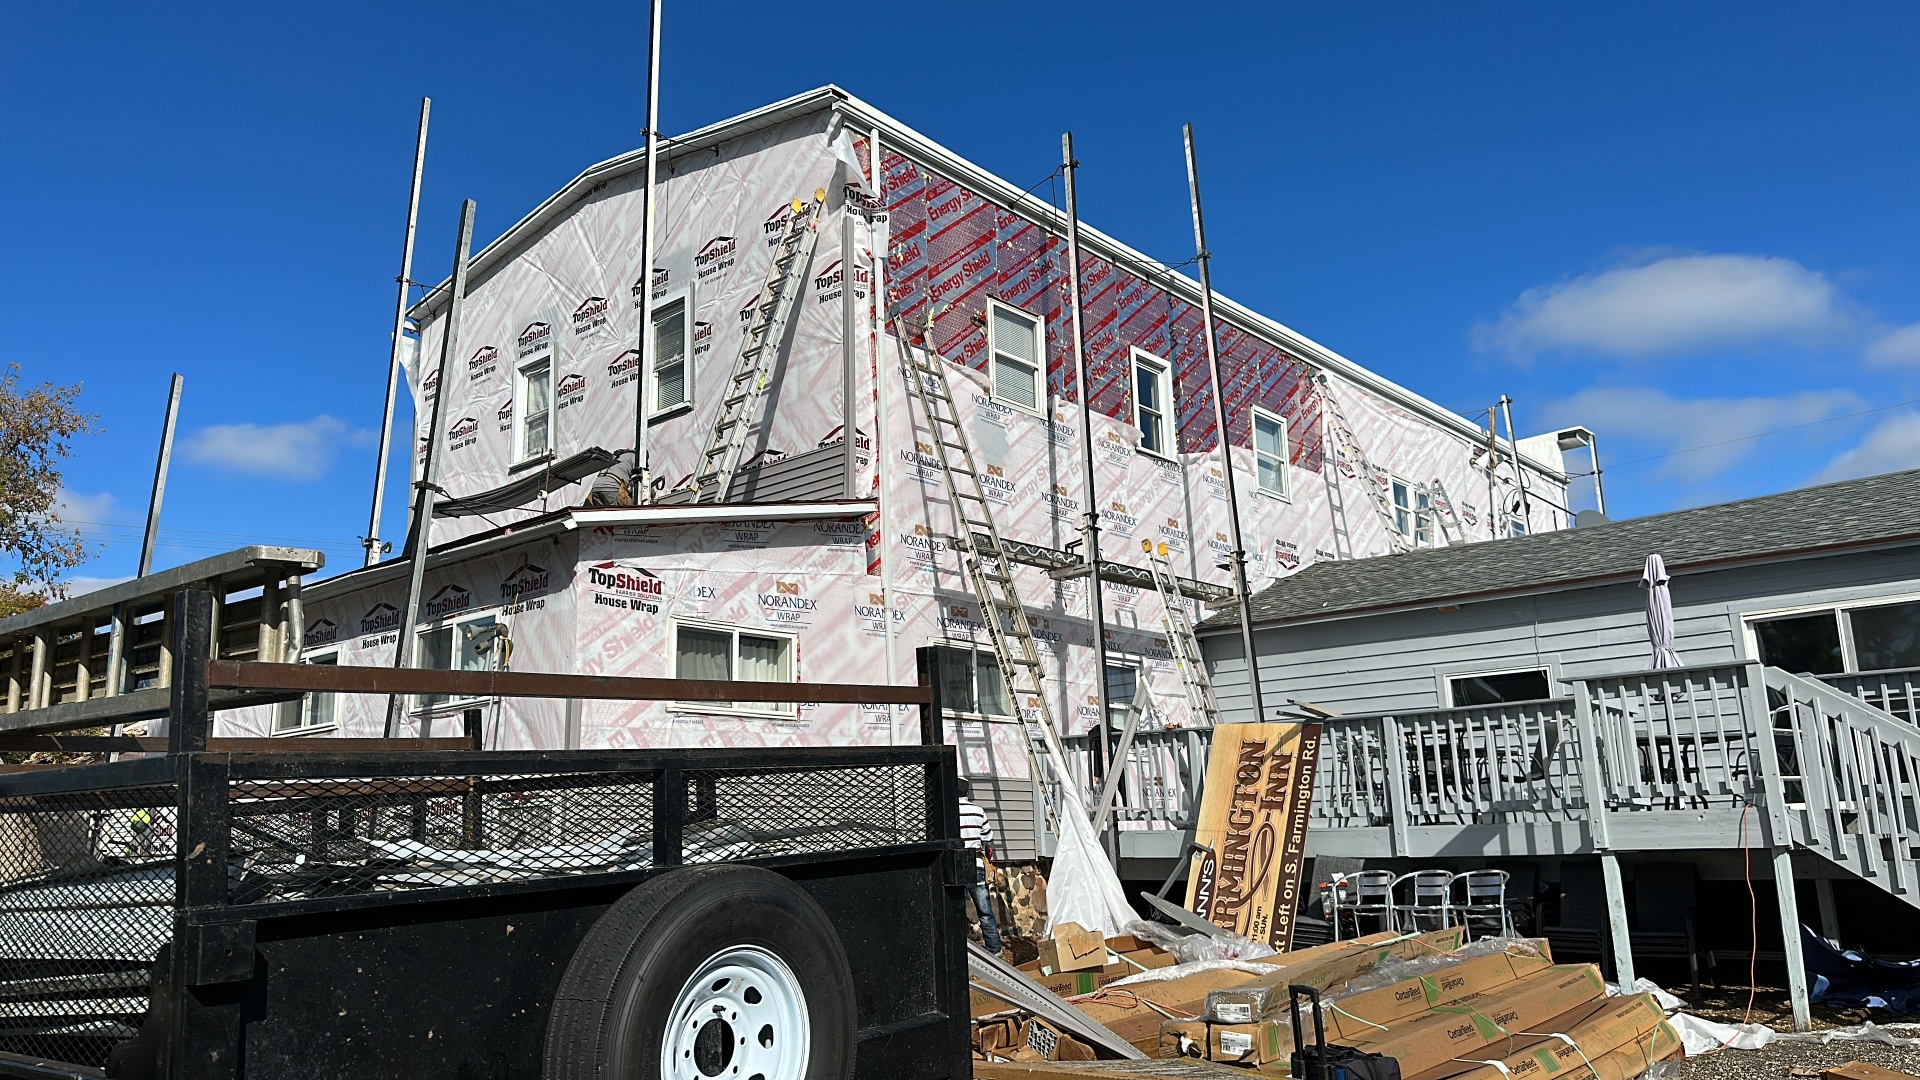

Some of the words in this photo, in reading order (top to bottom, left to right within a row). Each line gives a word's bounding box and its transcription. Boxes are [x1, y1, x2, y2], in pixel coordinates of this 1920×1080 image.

[886, 163, 919, 191] Shield
[927, 194, 962, 223] Energy
[870, 214, 887, 224] rap
[768, 234, 782, 247] Hou
[695, 238, 737, 267] TopShield
[888, 242, 921, 271] Shield
[698, 266, 717, 280] House
[717, 257, 735, 272] Wrap
[929, 271, 965, 305] Energy
[962, 248, 992, 278] Shield
[1087, 262, 1112, 287] Shield
[815, 270, 869, 290] TopSeld
[1000, 276, 1031, 303] Energy
[1028, 255, 1055, 281] Shield
[652, 288, 667, 300] Wrap
[819, 289, 842, 304] House
[1117, 286, 1142, 311] Energy
[573, 300, 608, 324] TopShield
[575, 322, 591, 335] House
[591, 316, 607, 329] Wrap
[518, 325, 550, 348] TopShield
[1090, 328, 1114, 356] Shield
[519, 347, 534, 359] House
[534, 341, 549, 353] Wrap
[695, 343, 711, 356] Wrap
[963, 334, 988, 359] Shiel
[469, 348, 498, 371] TopShield
[608, 357, 639, 377] TopShie
[470, 370, 484, 382] House
[484, 364, 496, 377] Wrap
[611, 376, 628, 389] House
[629, 371, 639, 383] Wr
[1260, 361, 1280, 384] Energy
[558, 398, 569, 410] ouse
[569, 394, 584, 407] Wrap
[1301, 399, 1320, 420] Energy
[985, 410, 1001, 420] WRAP
[448, 420, 479, 441] TopShield
[450, 441, 464, 452] House
[464, 437, 477, 448] Wrap
[1098, 438, 1132, 458] NORANDEX
[856, 454, 869, 467] rap
[901, 449, 943, 471] NORANDE
[915, 467, 934, 479] WRAP
[978, 472, 1016, 493] ORANDEX
[1202, 474, 1225, 489] NORAND
[988, 489, 1004, 498] WRAP
[1041, 491, 1079, 511] NORANDEX
[1053, 506, 1068, 517] WRAP
[1101, 508, 1137, 527] NORANDEX
[735, 532, 759, 541] WRAP
[1113, 523, 1128, 533] WRAP
[1158, 525, 1190, 541] NORANDEX
[832, 536, 853, 545] WRAP
[900, 534, 947, 553] NORANDEX
[915, 550, 934, 560] WRAP
[501, 573, 549, 599] TopShield
[588, 568, 662, 595] TopShield
[426, 593, 470, 616] TopShield
[502, 603, 524, 616] House
[526, 599, 545, 612] Wrap
[594, 593, 627, 609] House
[630, 599, 659, 615] Wrap
[758, 594, 818, 610] NORANDEX
[361, 611, 400, 632] TopShield
[777, 612, 801, 621] WRAP
[854, 605, 906, 622] NORANEX
[872, 621, 886, 630] WRA
[937, 616, 983, 631] NORANDEX
[303, 627, 337, 647] TopShield
[362, 638, 380, 649] House
[380, 634, 397, 645] Wrap
[1145, 648, 1174, 661] NORANDE
[1154, 660, 1170, 668] WRAP
[875, 714, 890, 723] WRA
[1077, 706, 1100, 720] NORAN
[1302, 736, 1317, 760] Rd.
[1259, 751, 1293, 814] INN
[1288, 765, 1312, 853] Farmington
[1212, 738, 1268, 934] RMINGTON
[1285, 858, 1297, 874] S.
[1197, 859, 1214, 918] NN'S
[1284, 879, 1294, 899] on
[1256, 906, 1262, 920] am
[1275, 904, 1291, 935] Left
[1260, 914, 1268, 935] SUN.
[1275, 940, 1286, 955] xt
[972, 994, 995, 1006] ASSIC
[1395, 986, 1421, 1002] CertainTeed
[1447, 1023, 1475, 1040] CertainTeed
[1509, 1058, 1537, 1075] CertainTeed
